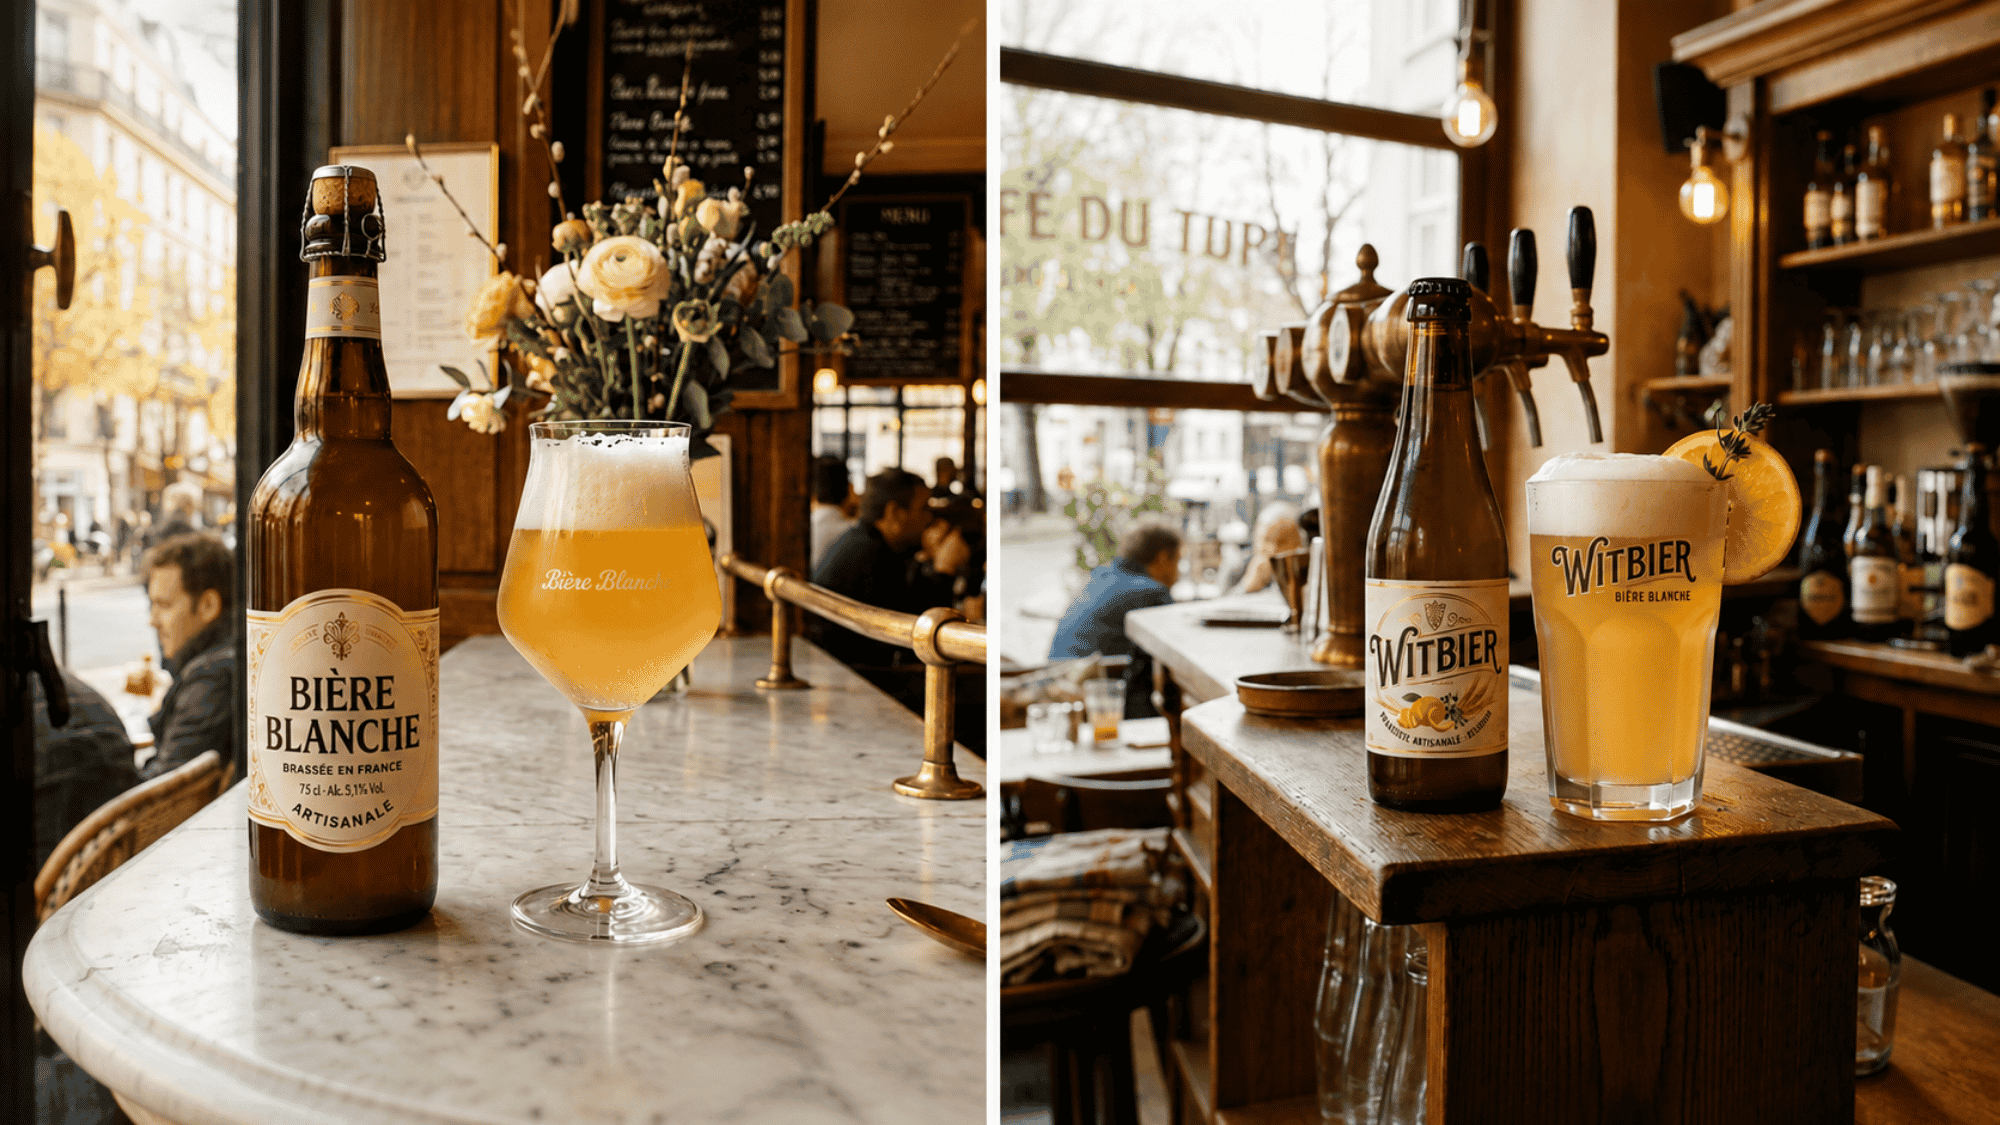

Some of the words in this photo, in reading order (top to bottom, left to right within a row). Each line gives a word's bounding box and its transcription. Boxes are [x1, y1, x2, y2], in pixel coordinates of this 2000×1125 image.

[1080, 195, 1149, 248] DU
[541, 568, 593, 590] Bière
[1615, 590, 1645, 603] BIÈRE
[1648, 590, 1691, 603] BLANCHE
[290, 668, 396, 712] BIÈRE
[265, 714, 421, 754] BLANCHE
[1413, 734, 1461, 747] ARTISANALE
[283, 762, 334, 776] BRASSÉE
[338, 764, 354, 776] EN
[358, 760, 403, 775] FRANCE
[299, 782, 311, 795] 75
[313, 784, 321, 796] cl
[369, 781, 385, 795] Vol.
[292, 799, 394, 829] ARTISANALE
